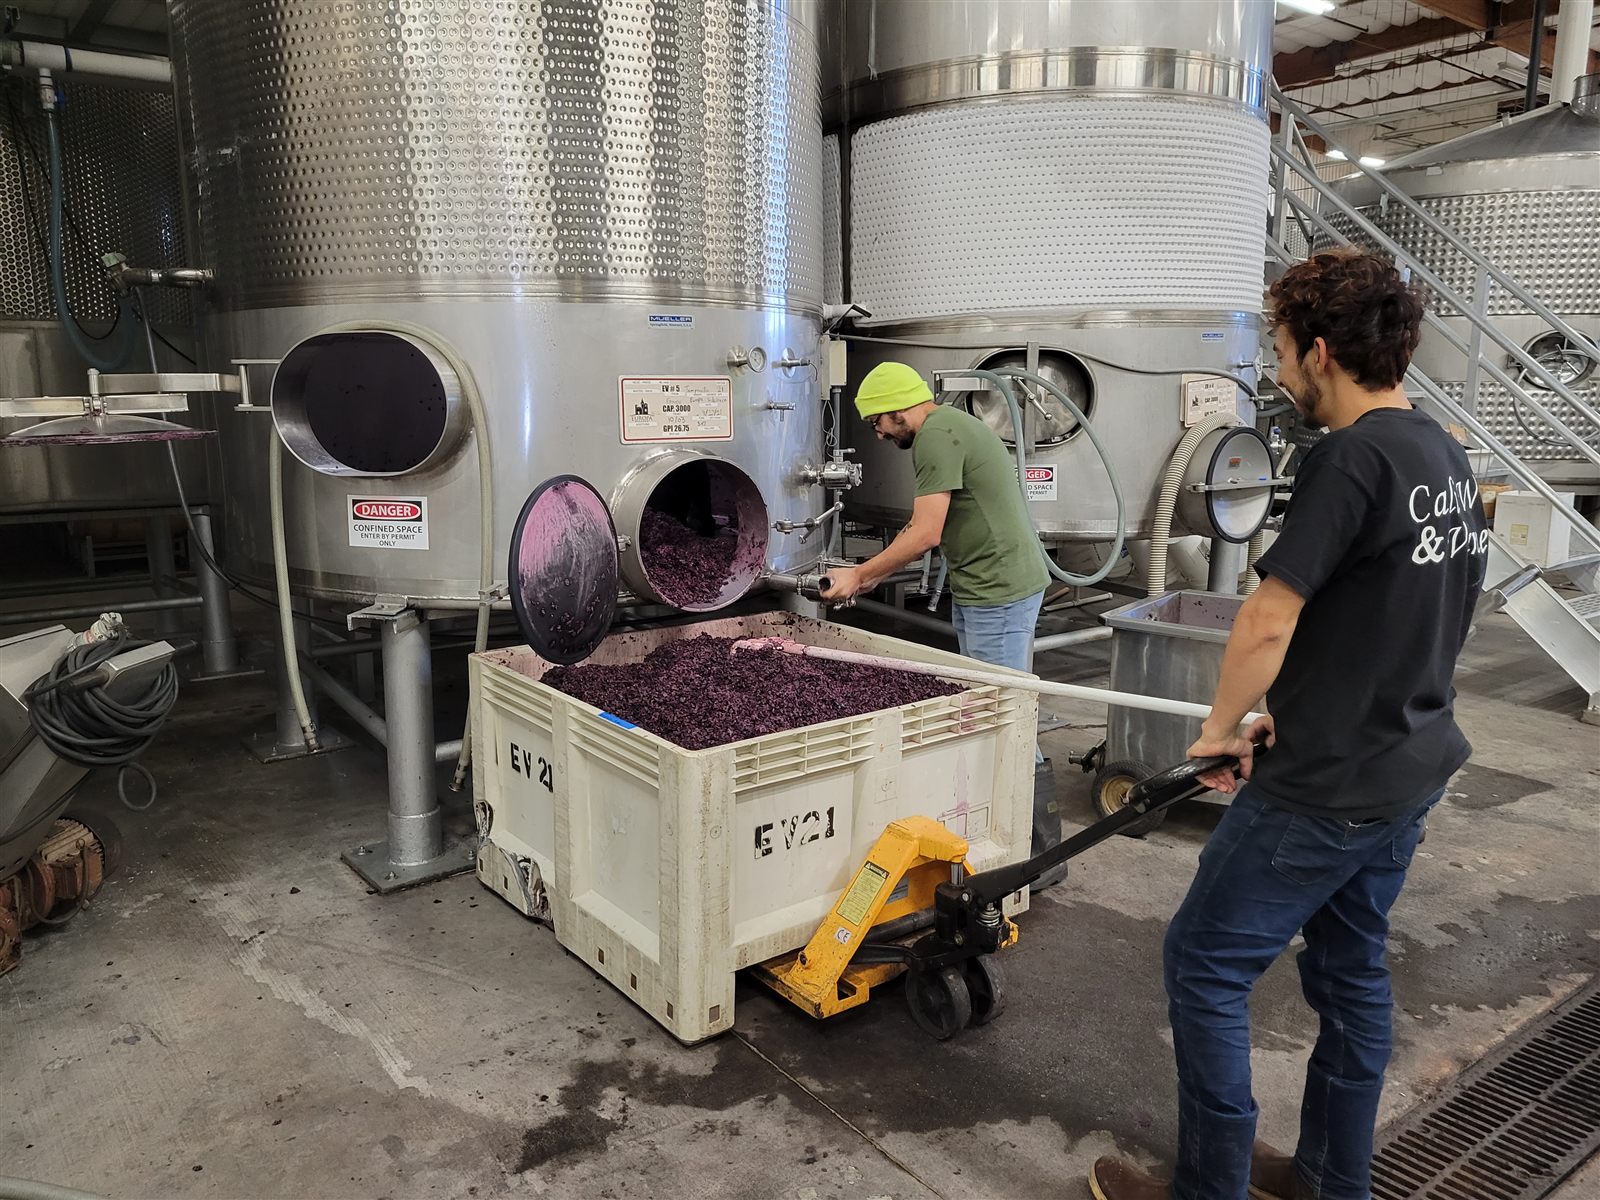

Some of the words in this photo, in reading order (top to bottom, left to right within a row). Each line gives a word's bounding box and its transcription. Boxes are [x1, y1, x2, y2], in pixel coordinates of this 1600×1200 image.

[675, 384, 680, 392] 5
[676, 404, 691, 412] 3000
[674, 424, 690, 432] 26.75
[361, 504, 412, 517] DANGER
[353, 524, 395, 533] CONFINED
[396, 525, 423, 534] SPACE
[1411, 525, 1445, 565] &
